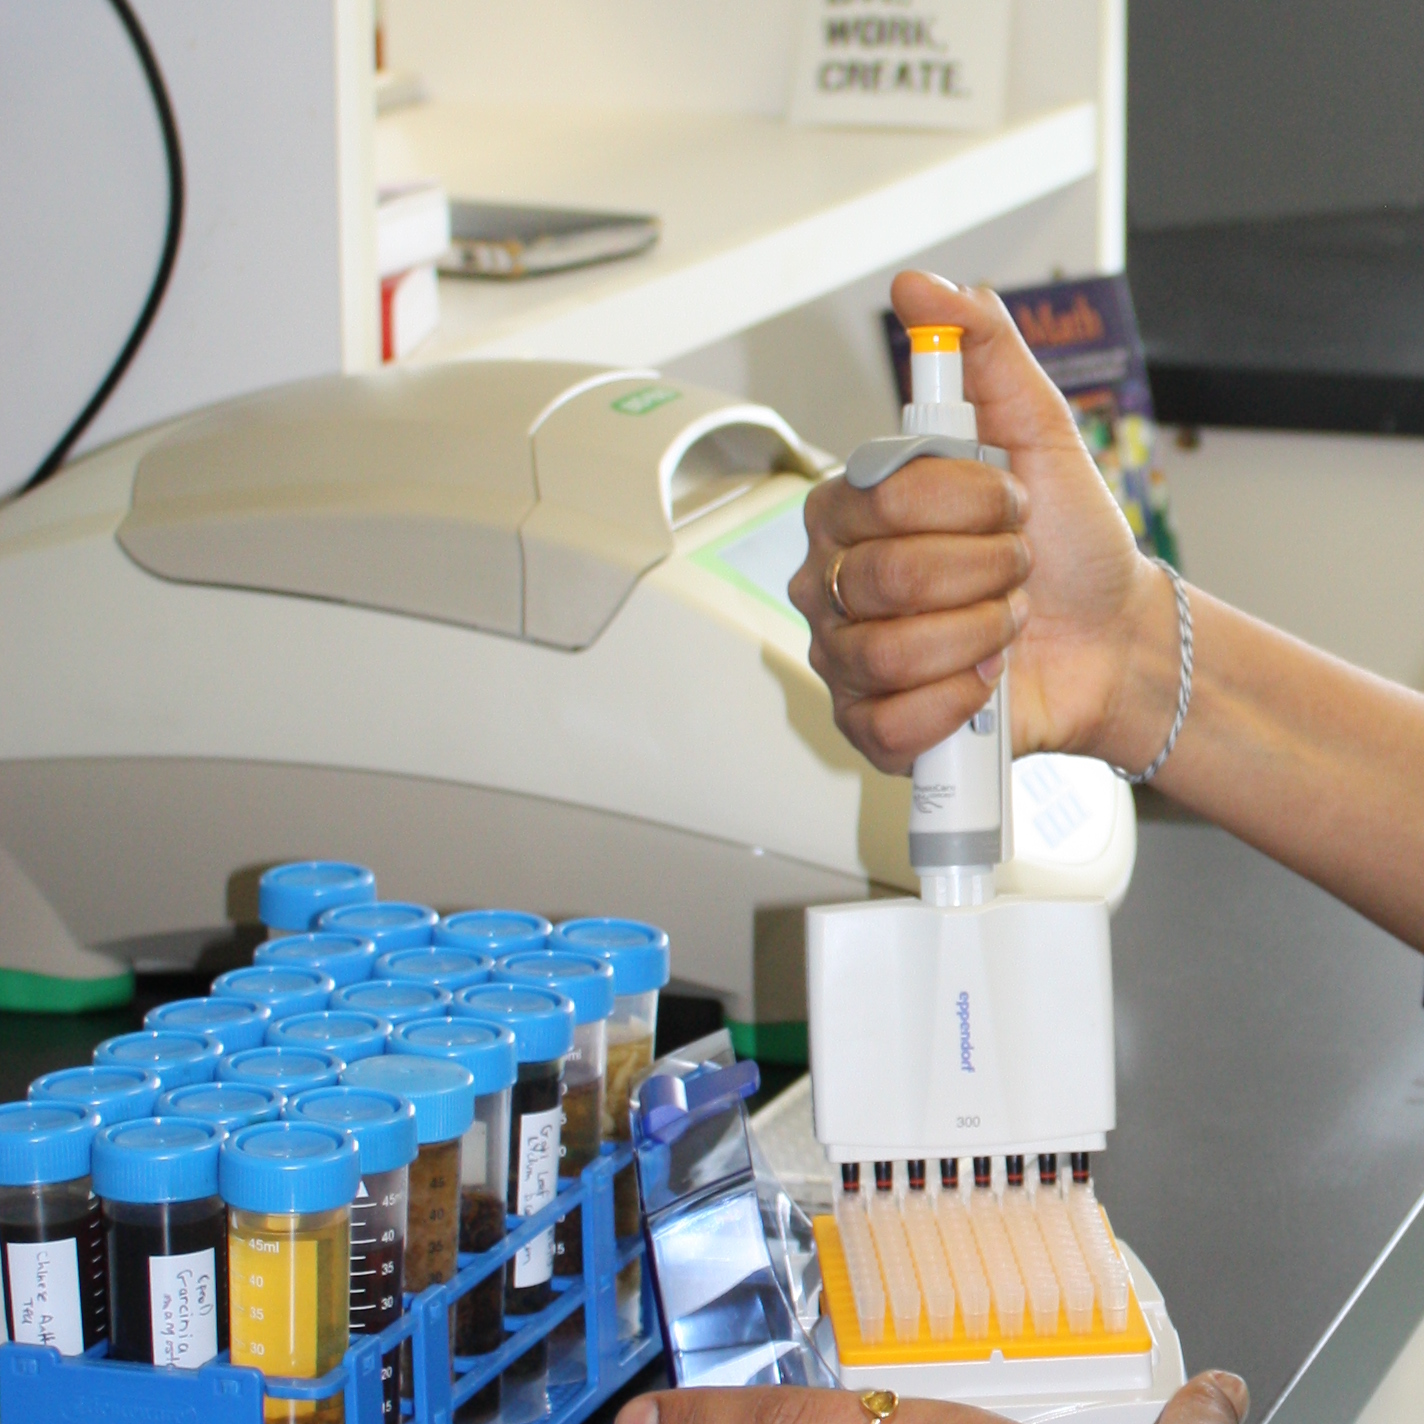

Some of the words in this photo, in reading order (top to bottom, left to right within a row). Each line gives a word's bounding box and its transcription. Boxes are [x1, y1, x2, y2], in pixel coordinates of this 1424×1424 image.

[956, 991, 976, 1073] eppendorf
[956, 1116, 981, 1129] 300
[381, 1229, 395, 1244] 40
[248, 1238, 280, 1254] 45ml
[381, 1261, 395, 1276] 35
[249, 1275, 264, 1288] 40
[380, 1296, 394, 1311] 30
[176, 1269, 194, 1354] Garcinia
[250, 1306, 265, 1320] 35
[250, 1342, 265, 1356] 30
